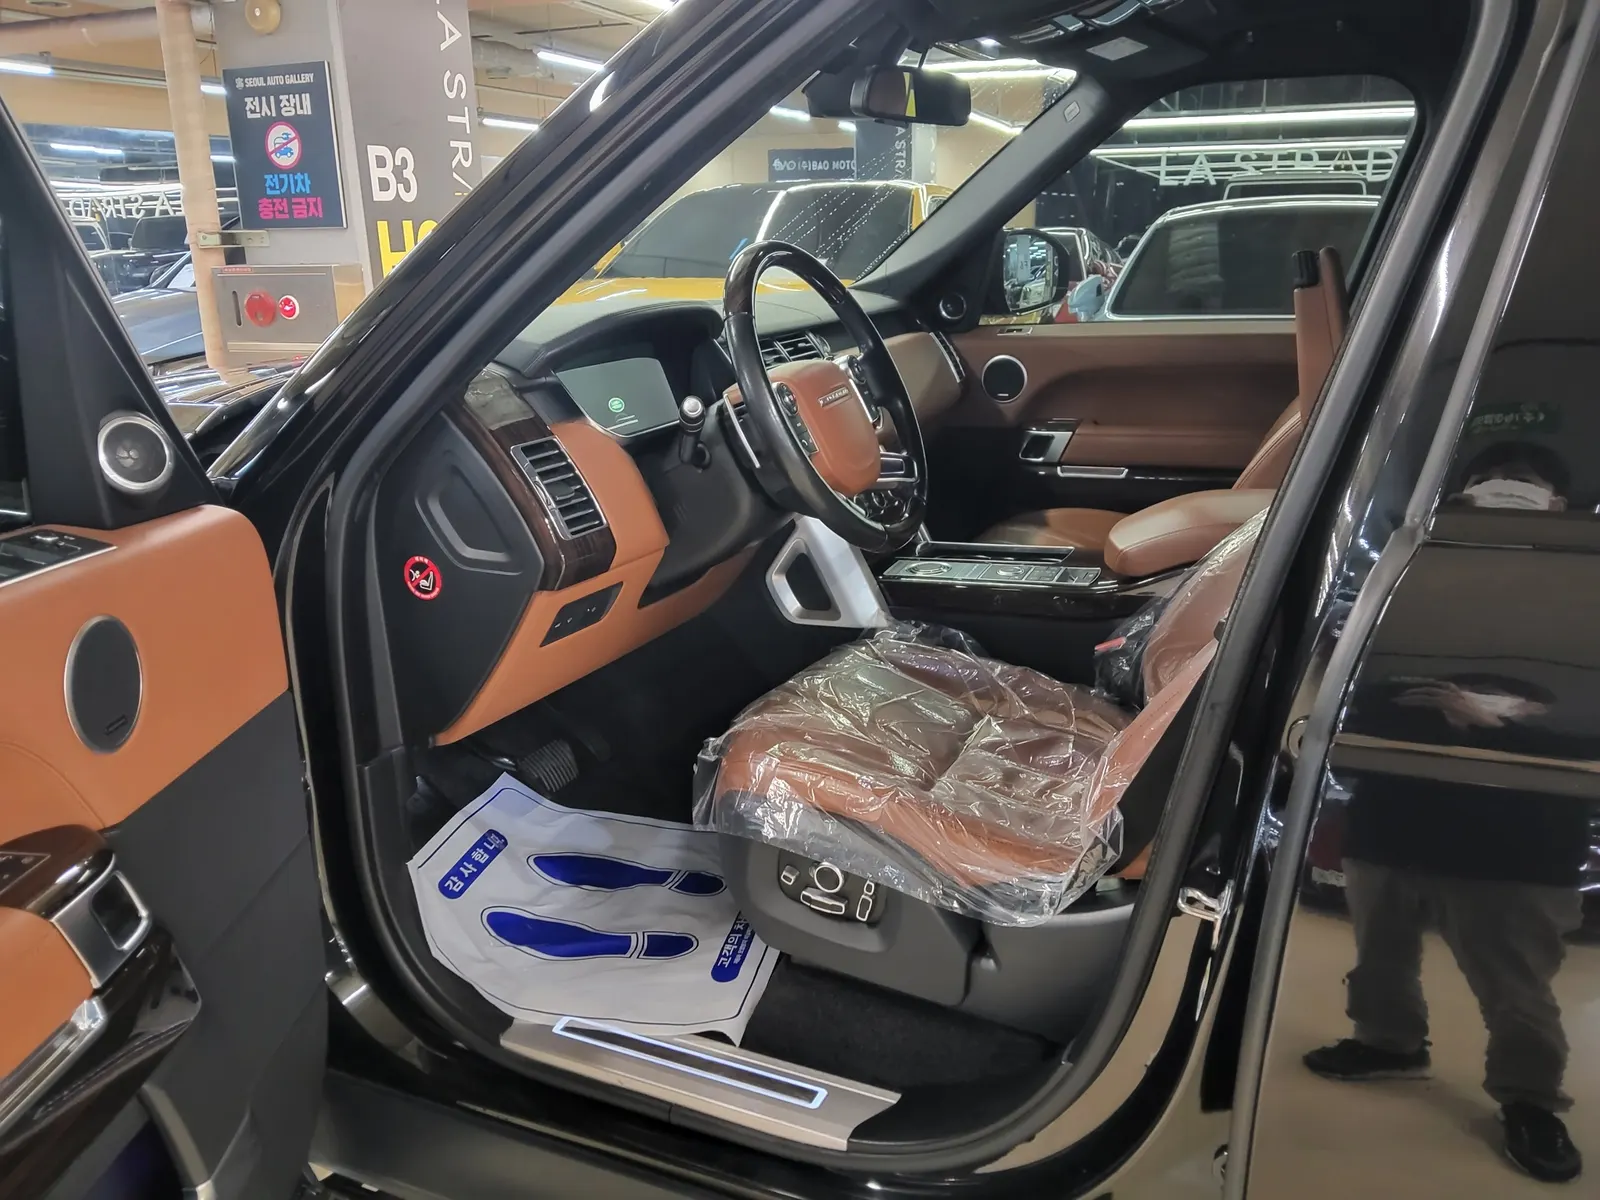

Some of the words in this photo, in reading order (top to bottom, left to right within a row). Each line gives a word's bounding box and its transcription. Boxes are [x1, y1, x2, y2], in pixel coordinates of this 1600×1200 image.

[436, 0, 462, 51] A
[245, 77, 266, 87] SEOUL
[266, 75, 285, 85] AUTO
[285, 73, 314, 85] GALLERY
[244, 95, 276, 119] 전시
[279, 93, 312, 117] 장내
[366, 144, 418, 203] B3
[1159, 150, 1217, 186] LA
[264, 173, 311, 195] 전기차
[292, 197, 323, 219] 금지
